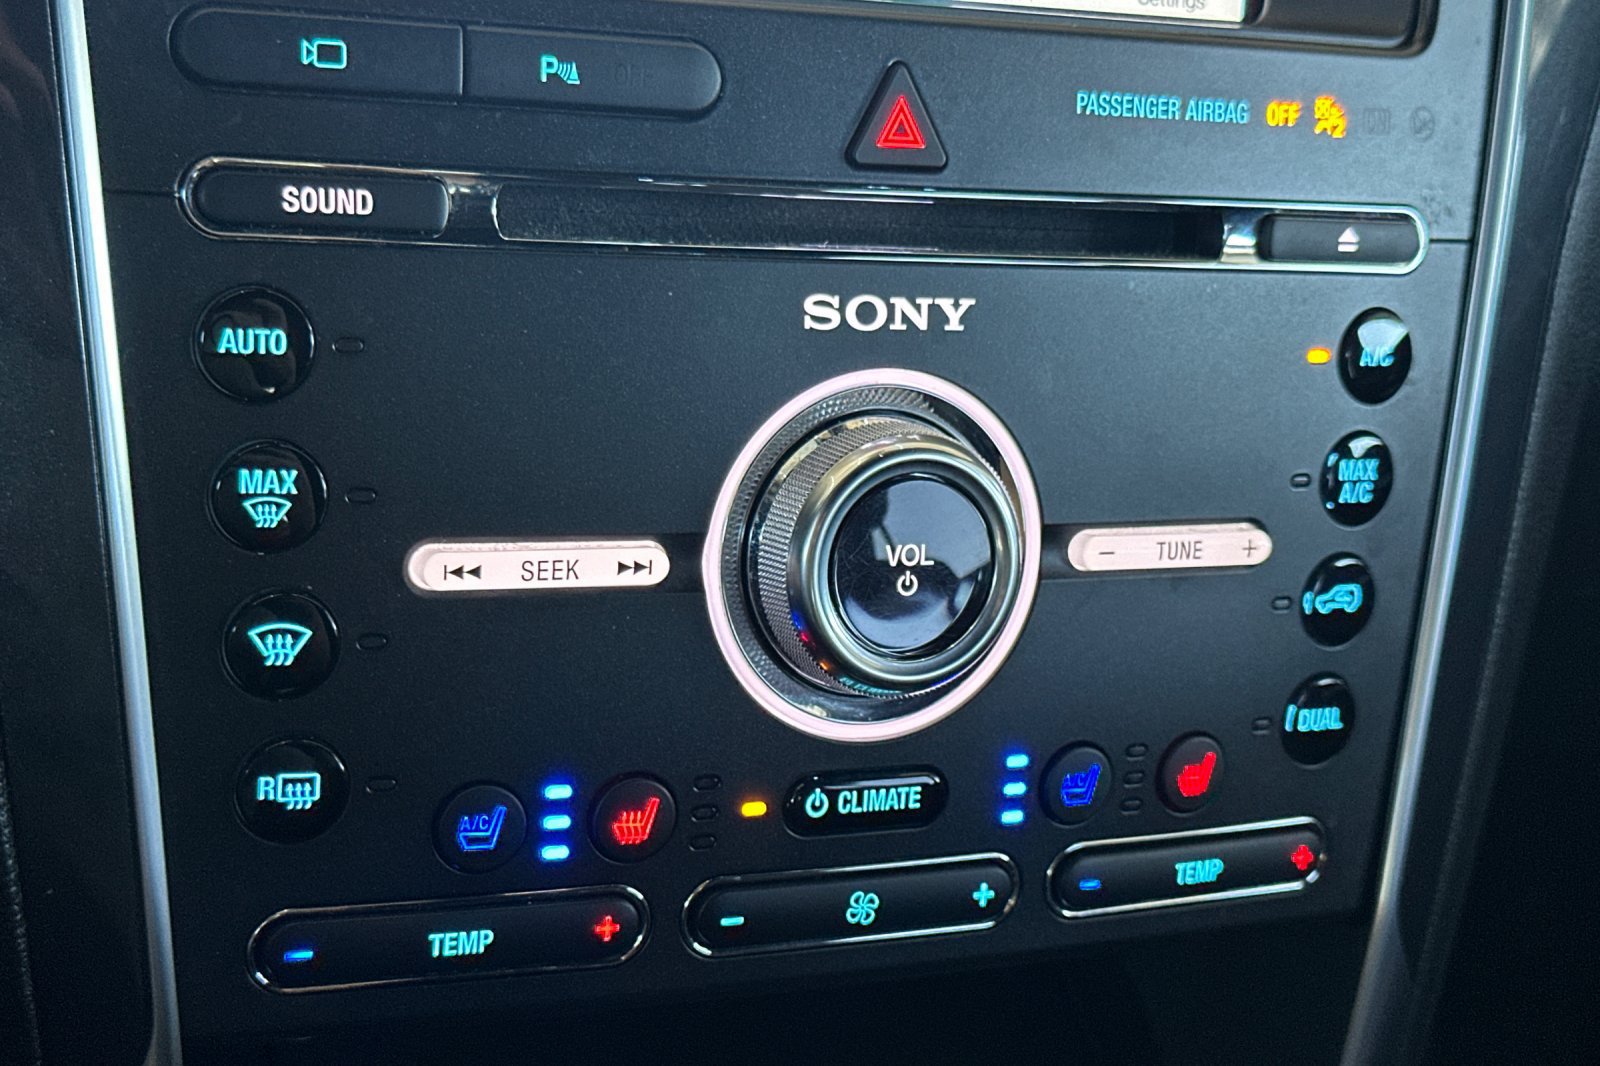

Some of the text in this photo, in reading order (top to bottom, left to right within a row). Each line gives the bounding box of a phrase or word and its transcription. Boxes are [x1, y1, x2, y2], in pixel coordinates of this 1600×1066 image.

[1076, 91, 1301, 127] PASSENGER AIRBAG OFF
[281, 186, 374, 216] SOUND
[803, 292, 977, 332] SONY
[216, 327, 288, 356] AUTO
[1359, 347, 1395, 367] A/C
[238, 468, 299, 495] MAX
[1337, 458, 1380, 482] MAX
[1338, 481, 1375, 504] A/C
[886, 543, 935, 567] VOL
[1156, 541, 1203, 561] TUNE
[521, 559, 580, 582] SEEK
[1297, 707, 1344, 732] DUAL
[837, 786, 922, 814] CLIMATE
[460, 813, 490, 832] A/C
[1174, 858, 1225, 886] TEMP
[428, 929, 495, 958] TEMP
